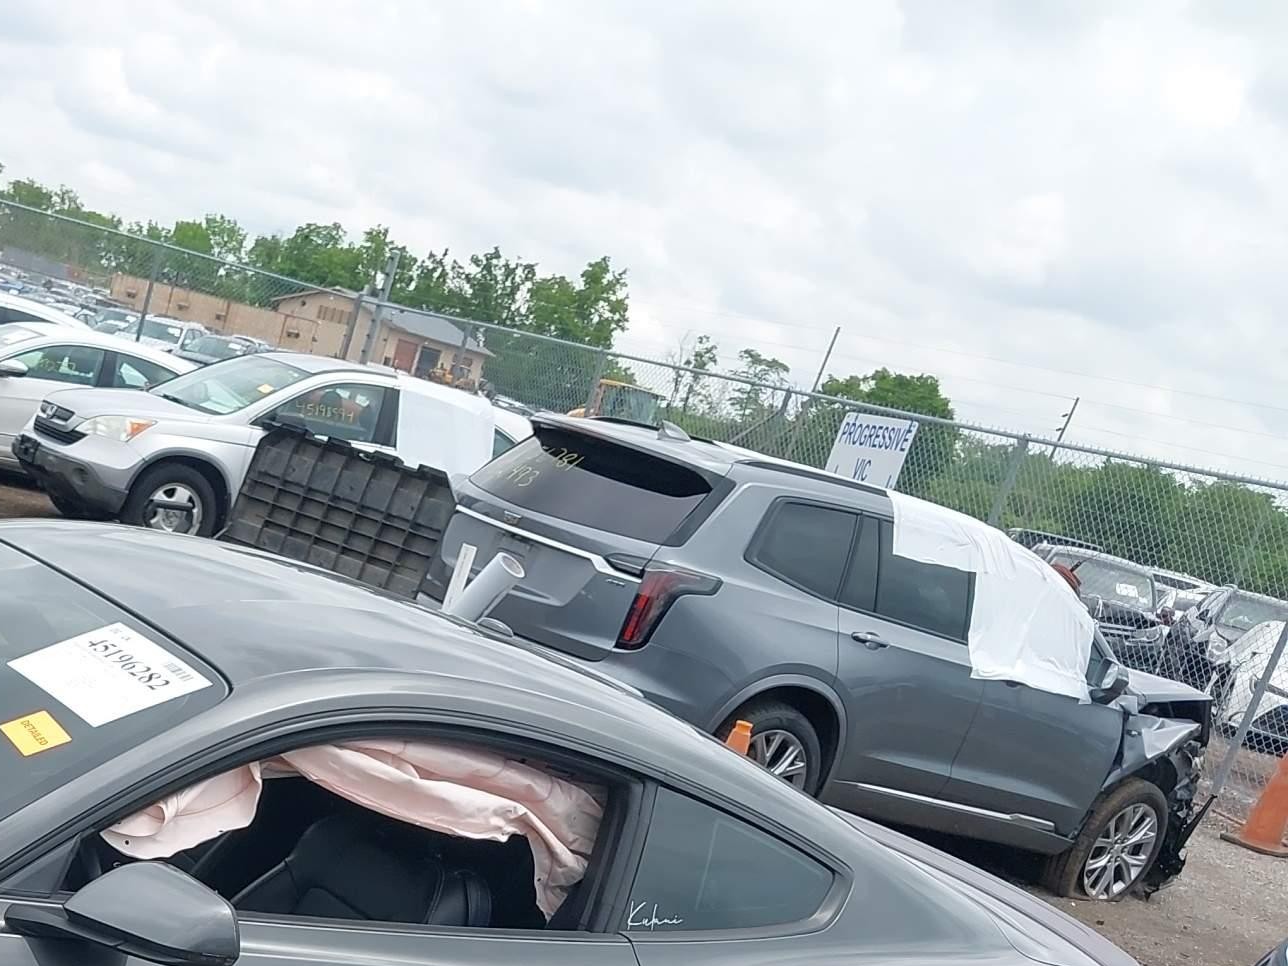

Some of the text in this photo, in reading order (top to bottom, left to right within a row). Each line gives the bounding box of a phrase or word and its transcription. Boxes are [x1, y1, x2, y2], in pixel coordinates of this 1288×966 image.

[838, 421, 914, 453] PROGRESSIVE
[852, 457, 872, 482] VIC
[86, 638, 172, 691] 45196282
